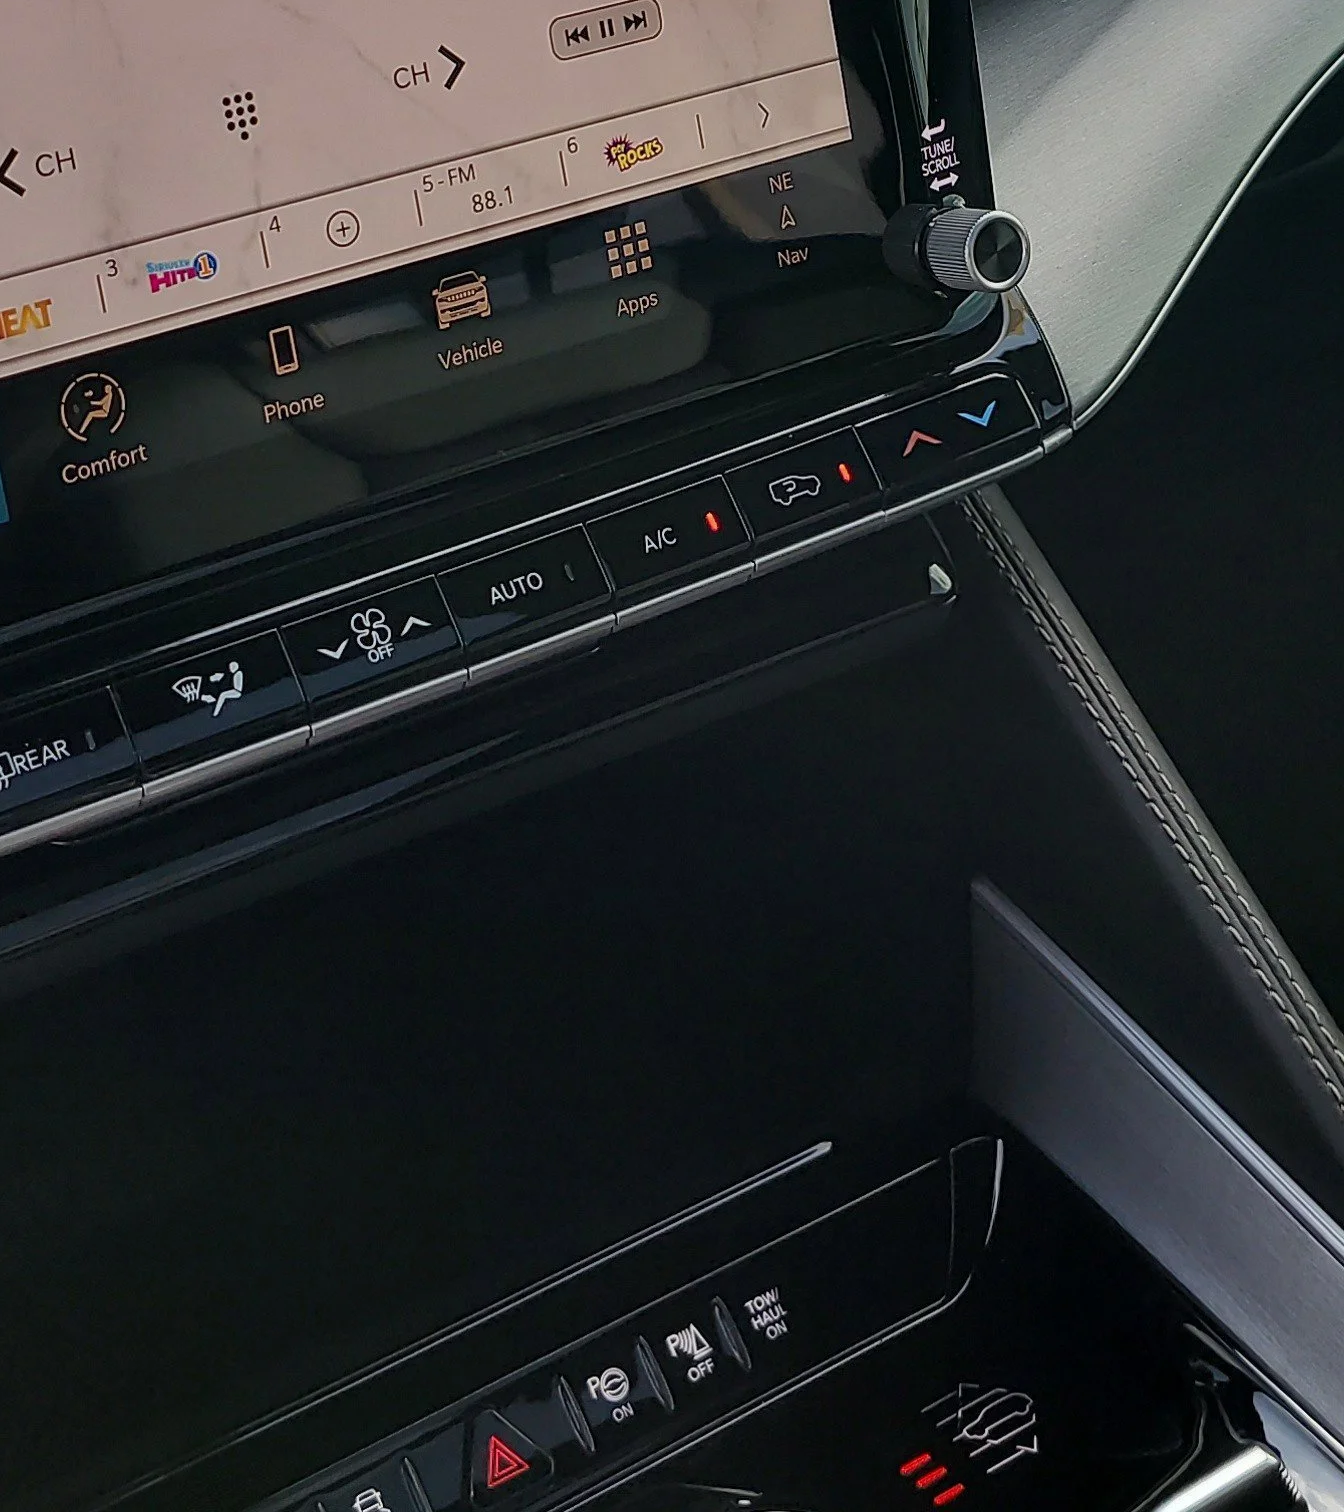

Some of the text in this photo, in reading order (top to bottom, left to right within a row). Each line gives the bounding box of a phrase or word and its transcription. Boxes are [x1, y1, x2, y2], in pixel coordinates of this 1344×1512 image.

[393, 61, 430, 90] CH
[566, 137, 579, 154] 6
[617, 139, 662, 170] ROCKS
[920, 136, 955, 161] TUNE/
[34, 147, 77, 178] CH
[921, 152, 960, 177] SCROLL
[769, 171, 794, 194] NE
[471, 185, 513, 214] 88.1
[268, 216, 282, 234] 4
[106, 259, 119, 278] 3
[777, 243, 810, 269] Nav
[616, 289, 660, 322] Apps
[437, 336, 505, 371] Vehicle
[263, 389, 326, 424] Phone
[61, 444, 148, 487] Comfort
[643, 526, 677, 554] A/C
[489, 572, 544, 606] AUTO
[367, 643, 395, 664] OFF
[13, 739, 72, 776] REAR
[743, 1287, 780, 1314] TOW/
[750, 1303, 788, 1331] HAUL
[766, 1320, 789, 1341] ON
[687, 1358, 716, 1382] OFF
[612, 1403, 634, 1423] ON
